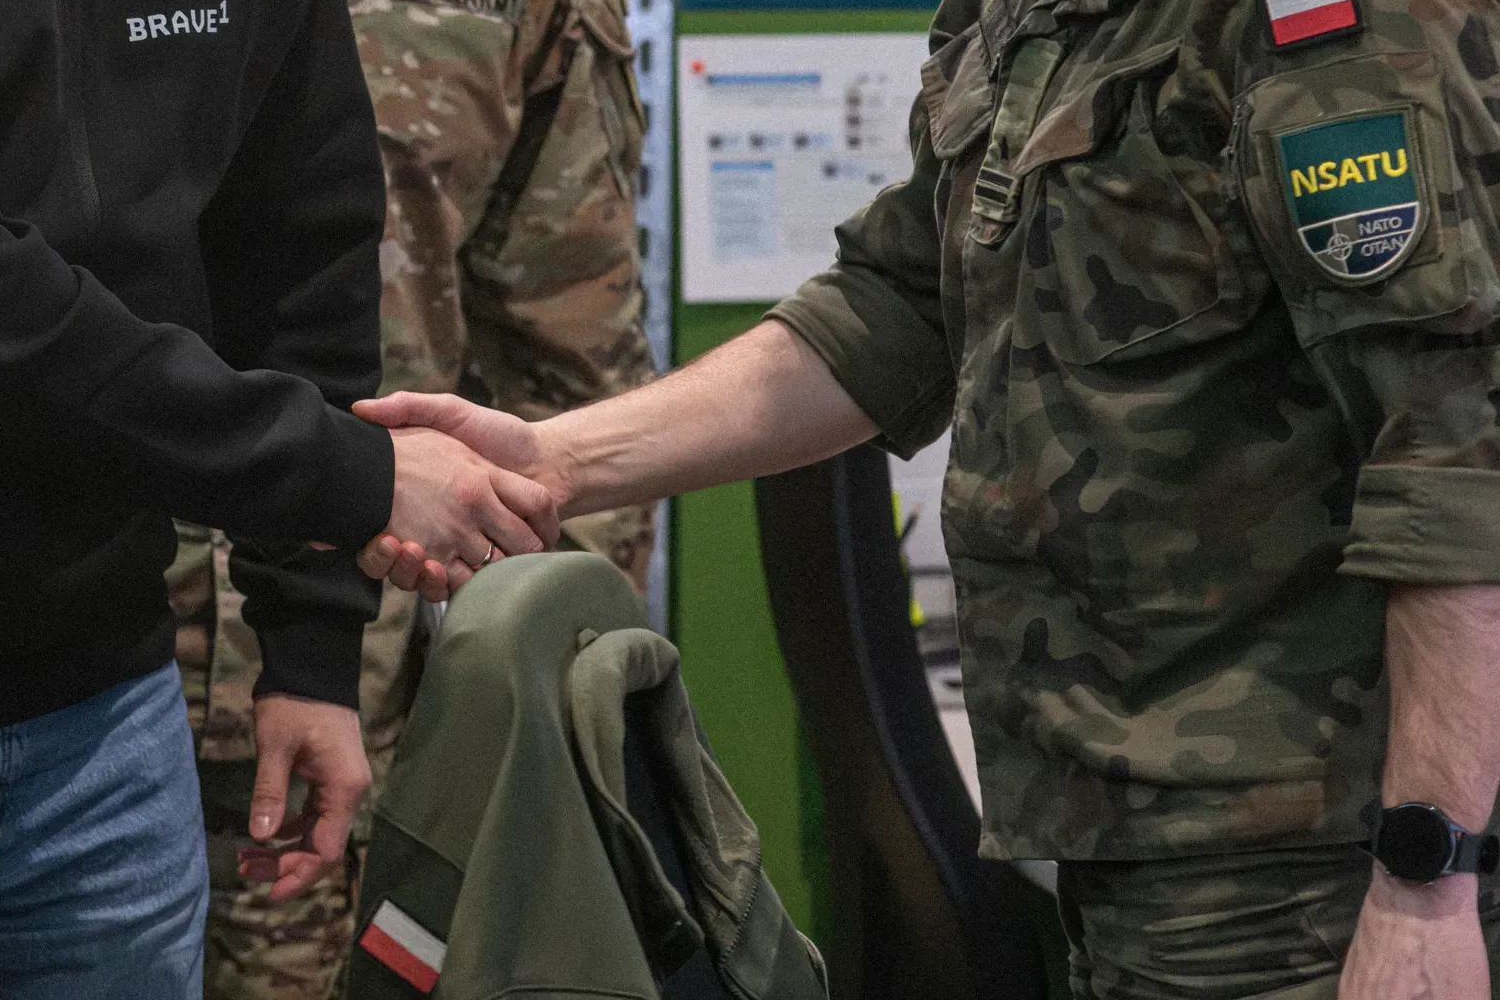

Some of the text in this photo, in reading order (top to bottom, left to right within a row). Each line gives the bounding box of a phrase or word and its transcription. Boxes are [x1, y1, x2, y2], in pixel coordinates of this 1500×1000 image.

[126, 0, 230, 42] BRAVE1
[1290, 148, 1409, 198] NSATU
[1358, 215, 1403, 235] NATO
[1360, 236, 1405, 258] OTAN
